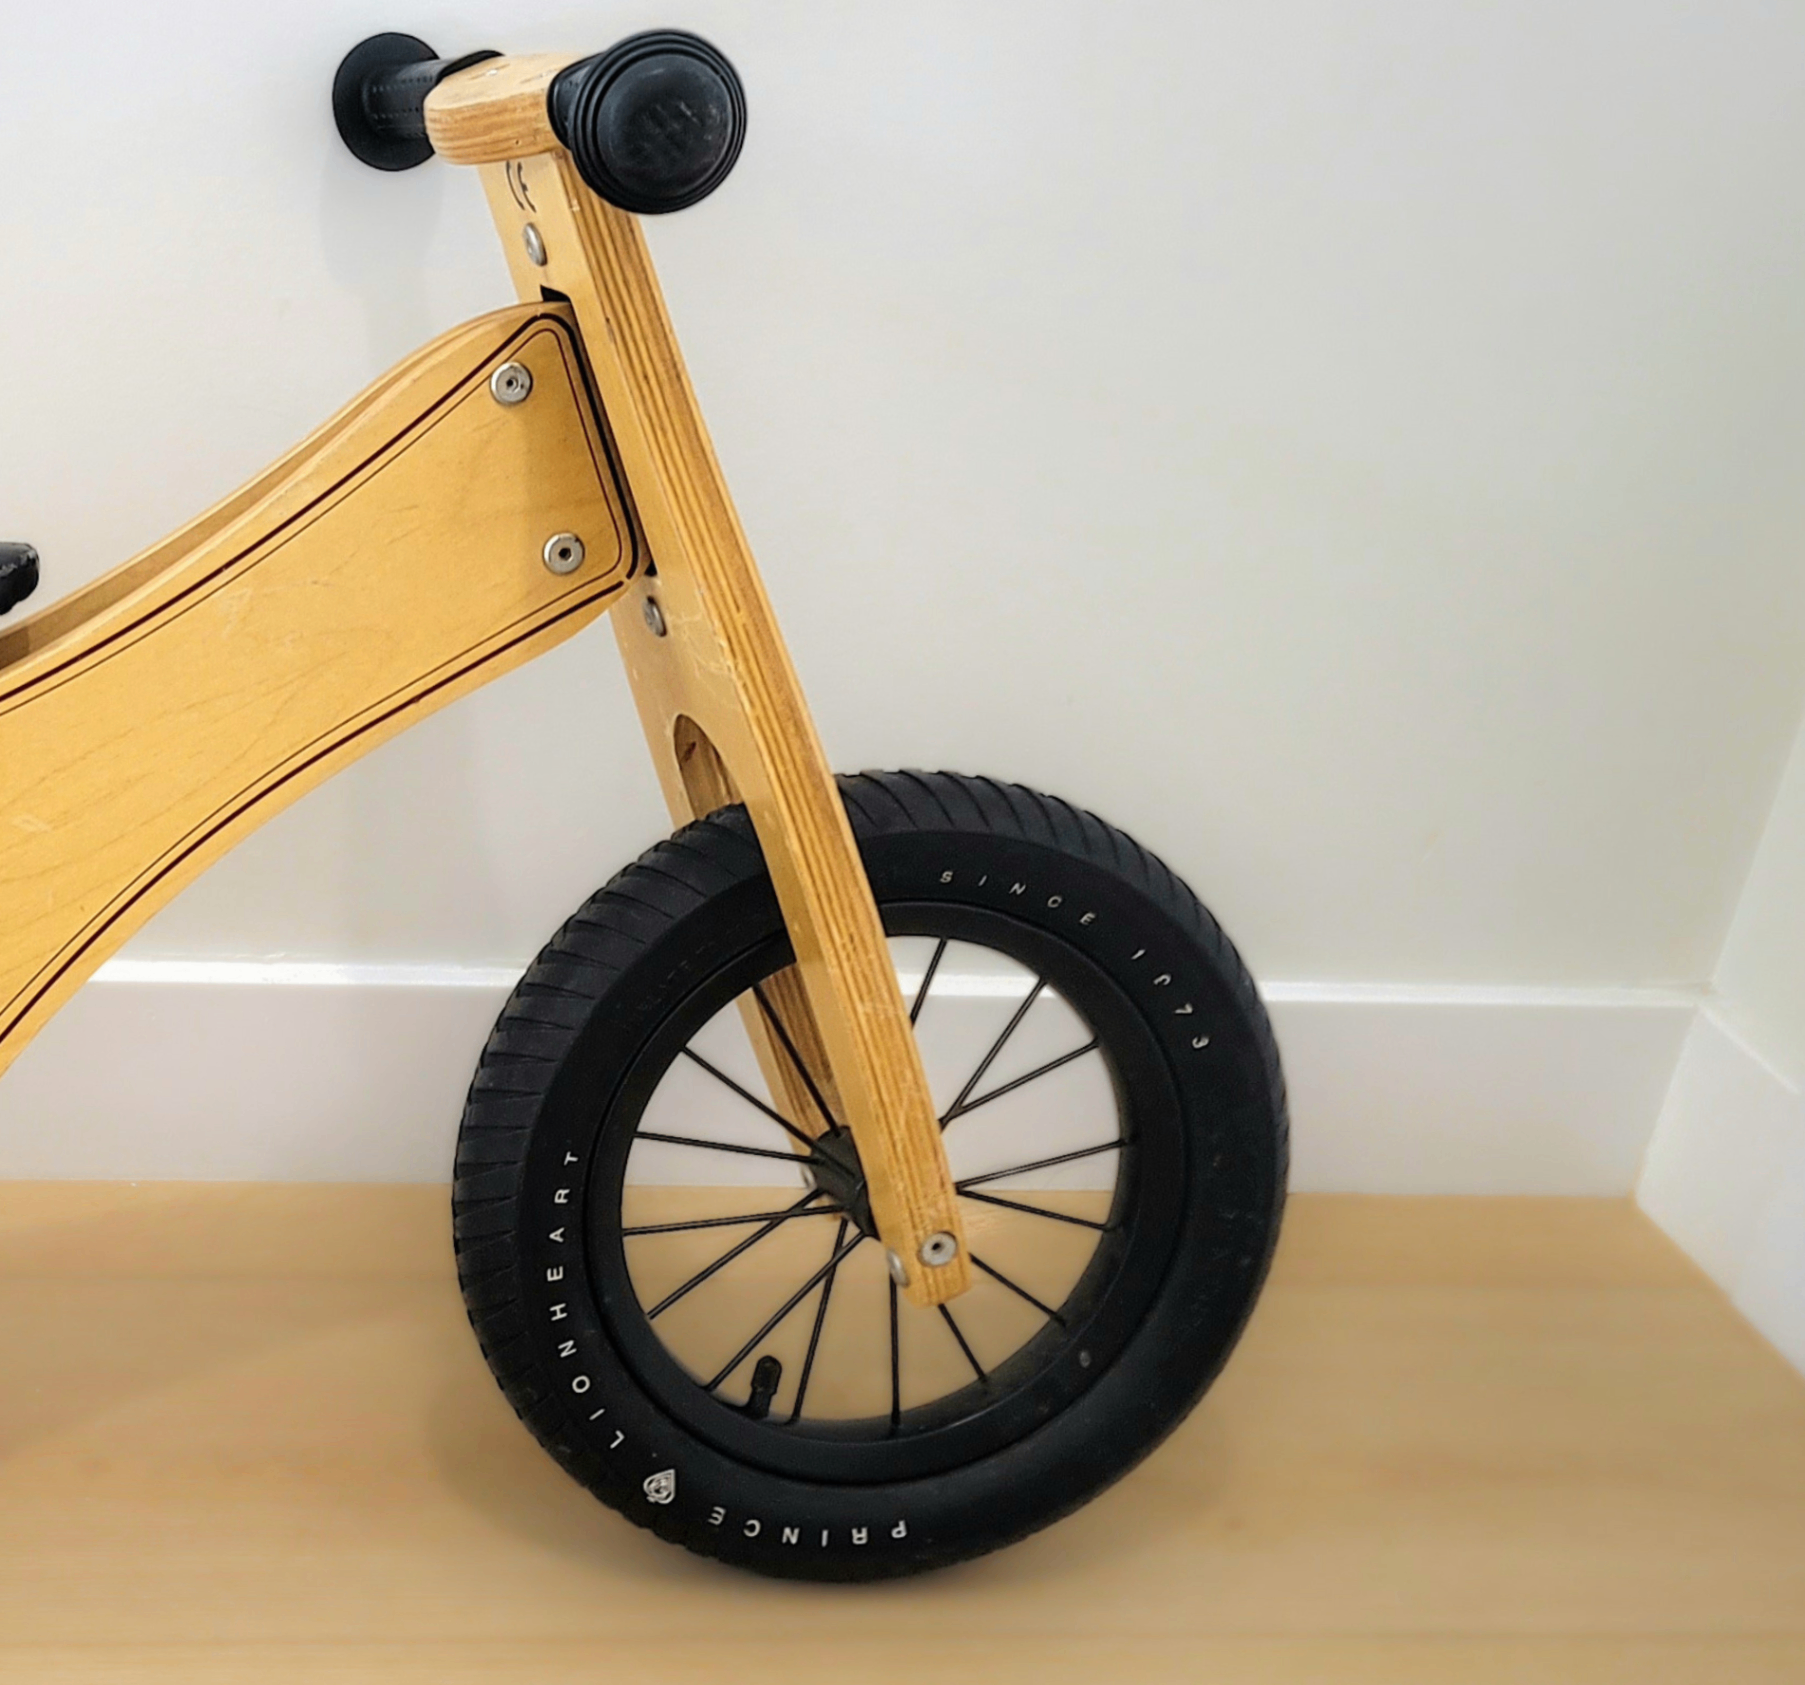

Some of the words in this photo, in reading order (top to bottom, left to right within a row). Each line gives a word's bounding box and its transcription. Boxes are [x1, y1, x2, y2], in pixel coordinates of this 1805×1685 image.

[940, 871, 1095, 924] SINCE
[546, 1151, 624, 1449] LIONHEART
[708, 1506, 907, 1547] PRINCE
